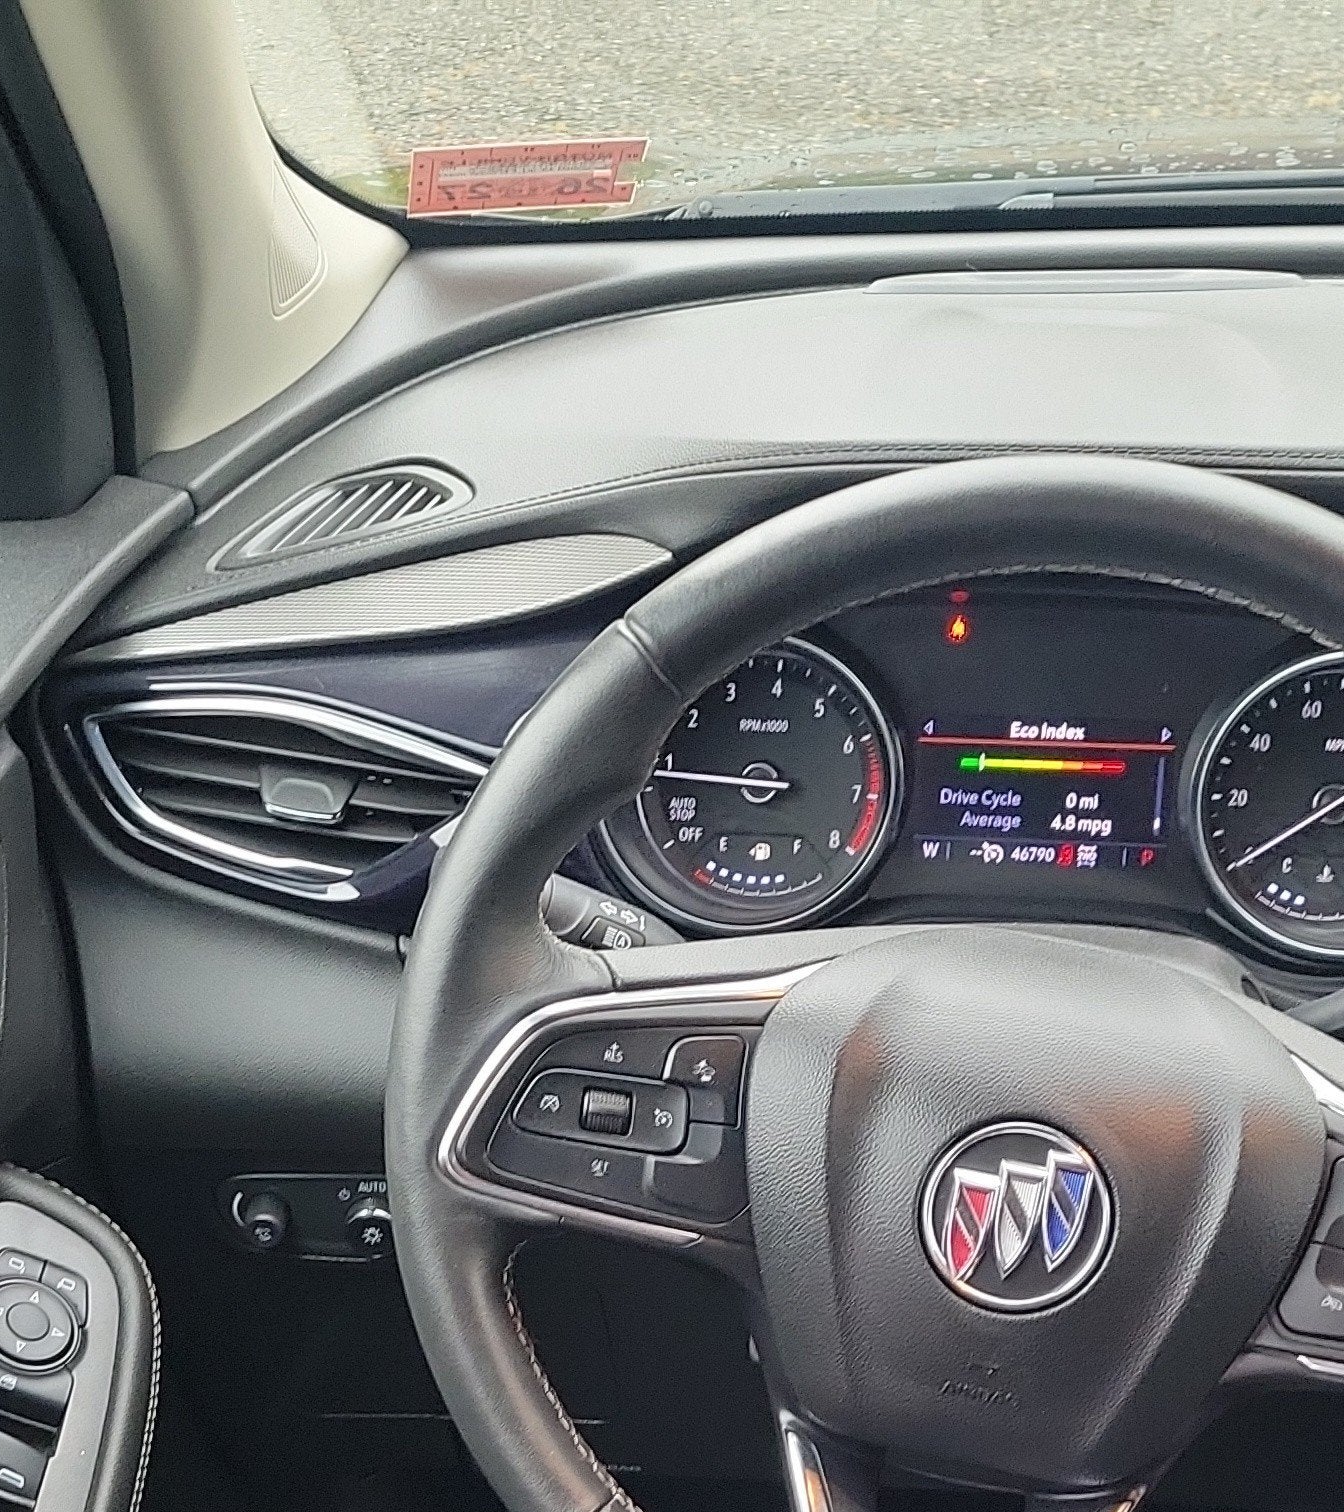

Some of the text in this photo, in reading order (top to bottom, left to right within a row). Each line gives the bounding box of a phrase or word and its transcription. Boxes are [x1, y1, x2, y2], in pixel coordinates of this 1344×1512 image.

[725, 683, 737, 702] 3
[771, 677, 783, 698] 4
[813, 698, 826, 718] 5
[1302, 699, 1323, 719] 60
[687, 709, 700, 729] 2
[1009, 720, 1086, 742] Eco Index
[842, 735, 855, 755] 6
[1249, 732, 1272, 752] 40
[664, 753, 674, 771] 1
[669, 796, 697, 810] AUTO
[851, 784, 862, 805] 7
[939, 787, 1022, 811] Drive Cycle
[1065, 792, 1100, 811] 0 mi
[1227, 788, 1249, 808] 20
[669, 808, 696, 822] STOP
[959, 810, 1022, 833] Average
[678, 826, 704, 843] OFF
[1050, 814, 1113, 837] 4.8 mpg
[718, 836, 729, 853] E
[793, 838, 803, 855] F
[828, 830, 840, 849] 8
[922, 841, 940, 859] W
[1010, 846, 1056, 864] 46790
[1282, 857, 1293, 875] C
[358, 1180, 387, 1194] AUTO
